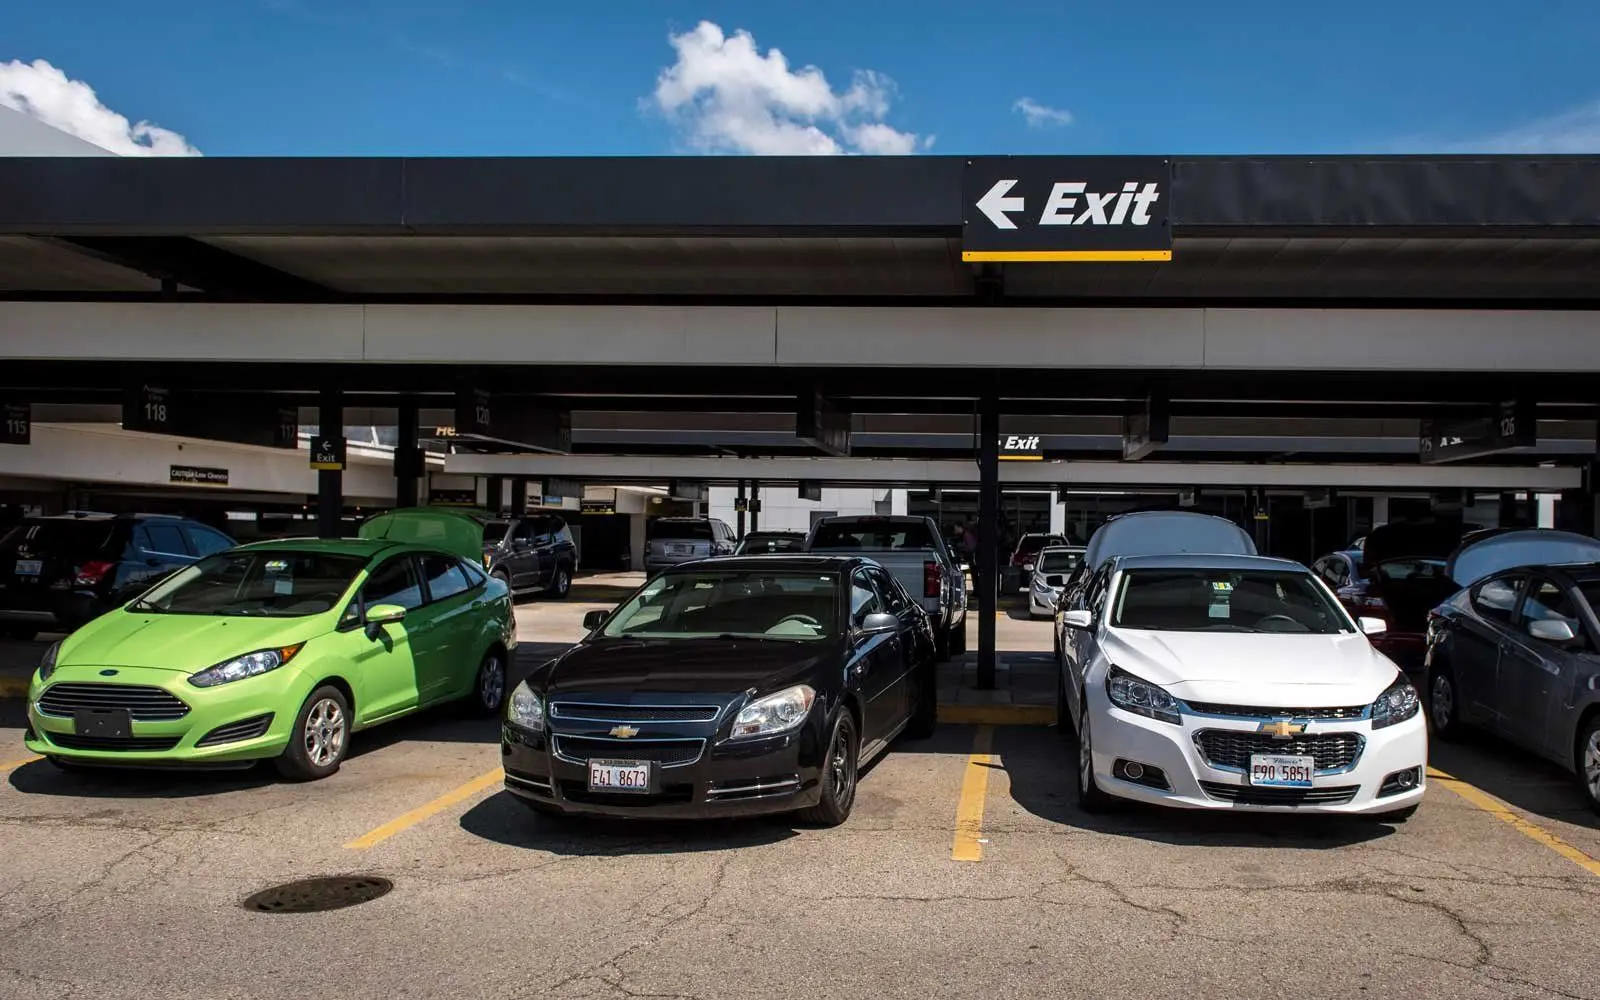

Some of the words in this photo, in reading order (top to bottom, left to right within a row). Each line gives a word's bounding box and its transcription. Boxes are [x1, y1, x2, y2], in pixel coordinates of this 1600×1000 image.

[1038, 182, 1160, 225] Exit
[144, 403, 168, 421] 118
[475, 405, 490, 425] 120
[7, 420, 28, 435] 115
[280, 423, 296, 440] 117
[435, 426, 457, 437] He
[1500, 416, 1515, 437] 126
[1004, 435, 1040, 450] Exit
[316, 452, 336, 463] Exit
[592, 769, 612, 786] E41
[619, 770, 646, 787] 8673
[1254, 765, 1275, 780] E90
[1282, 766, 1310, 782] 5851
